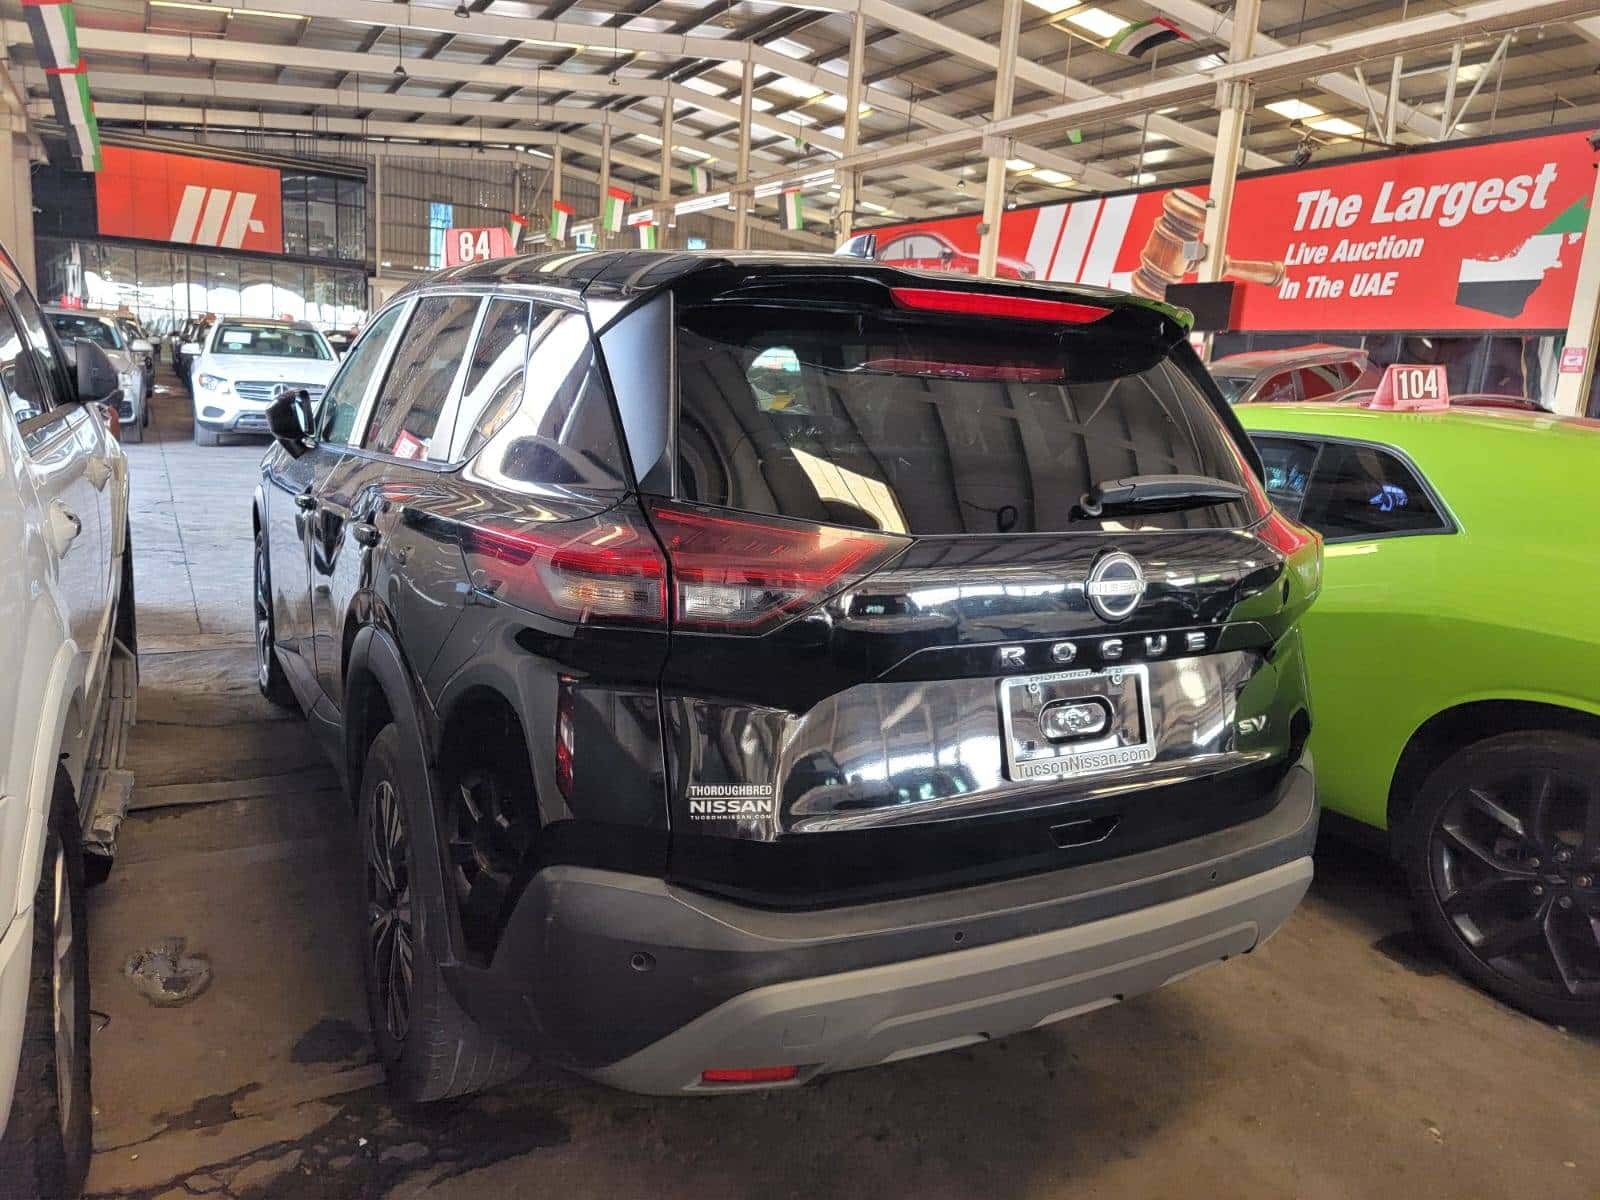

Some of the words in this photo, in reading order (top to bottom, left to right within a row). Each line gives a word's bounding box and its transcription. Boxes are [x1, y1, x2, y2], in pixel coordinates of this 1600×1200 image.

[1293, 189, 1363, 232] The
[1370, 162, 1558, 227] Largest
[460, 230, 490, 262] 84
[1284, 242, 1329, 266] Live
[1331, 235, 1425, 263] Auction
[1278, 277, 1301, 299] In
[1304, 275, 1345, 299] The
[1349, 271, 1400, 297] UAE
[1399, 368, 1438, 400] 104
[1000, 632, 1208, 667] ROGUE
[1239, 715, 1266, 735] SV
[1016, 748, 1151, 779] TucsonNissan.com
[690, 785, 772, 796] THOROUGHBRED
[690, 800, 772, 814] NISSAN
